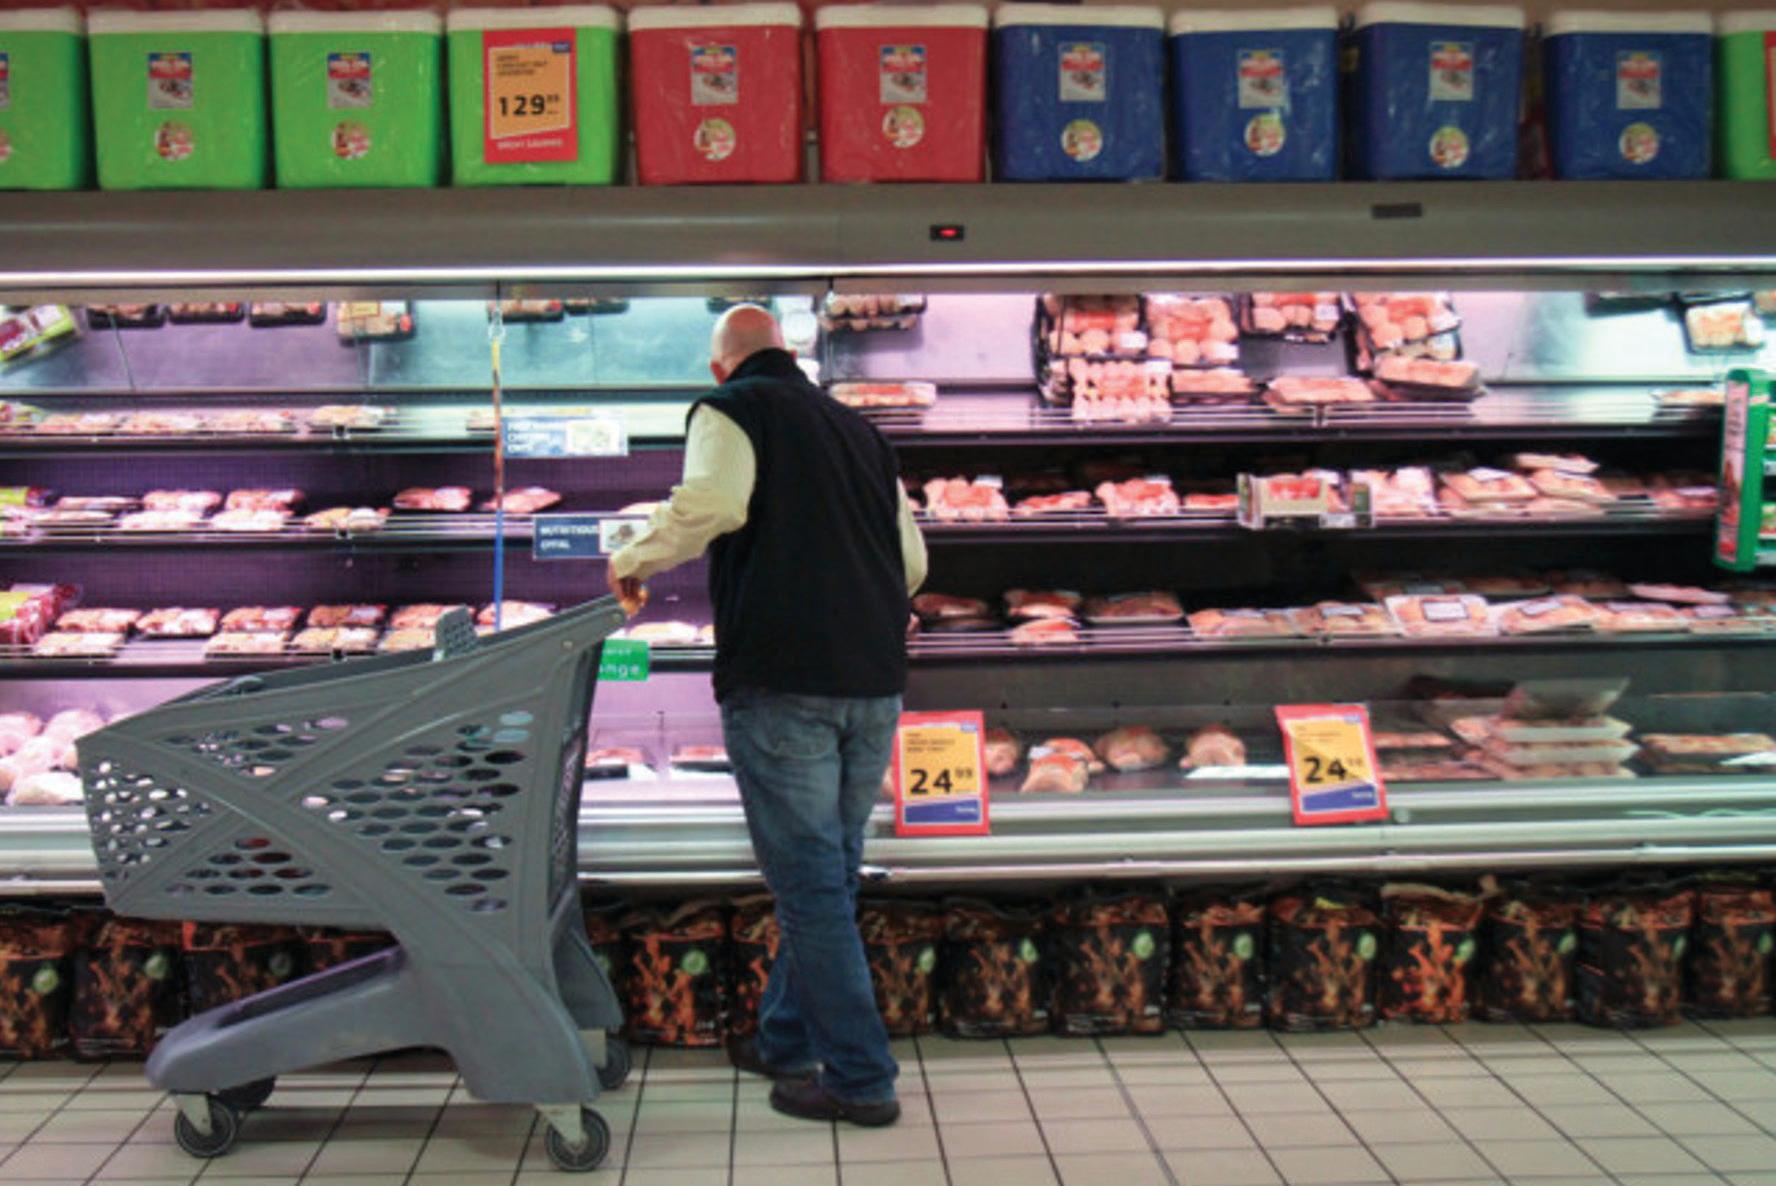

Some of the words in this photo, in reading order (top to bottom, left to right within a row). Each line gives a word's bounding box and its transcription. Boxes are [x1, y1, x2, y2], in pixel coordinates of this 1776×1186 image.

[498, 94, 546, 117] 129
[910, 768, 953, 795] 24
[1303, 755, 1348, 783] 24
